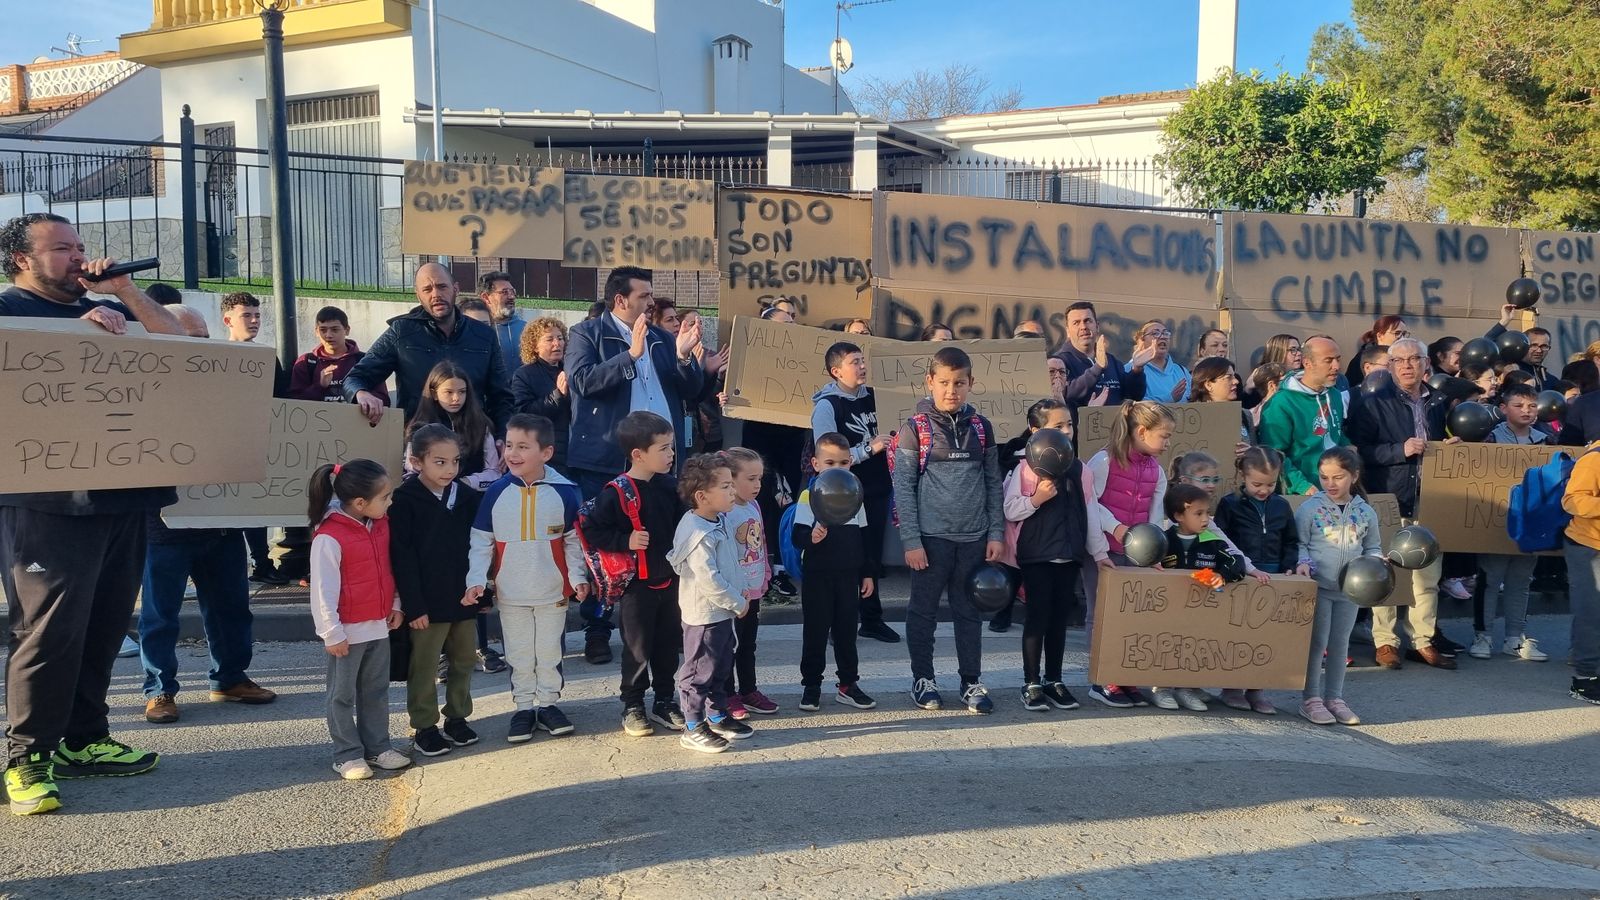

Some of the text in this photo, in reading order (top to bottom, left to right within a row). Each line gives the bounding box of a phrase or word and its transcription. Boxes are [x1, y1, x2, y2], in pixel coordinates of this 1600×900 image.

[404, 160, 459, 187] QUE
[565, 175, 598, 203] EL
[467, 184, 564, 217] PASAR
[727, 193, 834, 227] TODO
[579, 202, 688, 231] SE NOS
[458, 215, 487, 256] ?
[565, 234, 714, 266] CAE ENCIMA
[728, 228, 793, 256] SON
[1232, 220, 1489, 265] LA JUNTA NO
[1536, 236, 1594, 263] CON
[728, 256, 872, 293] PREGUNTAS
[1541, 271, 1600, 304] SEG
[1270, 269, 1445, 328] CUMPLE
[744, 326, 794, 350] VALLA
[2, 340, 266, 378] LOS PLAZOS SON LOS
[776, 356, 809, 373] NOS
[881, 358, 907, 382] LA
[999, 353, 1027, 374] EL
[22, 382, 76, 407] QUE
[1001, 379, 1028, 397] NO
[268, 402, 332, 433] MOS
[14, 438, 196, 474] PELIGRO
[266, 439, 348, 469] UDIAR
[251, 476, 310, 499] SEG
[1120, 580, 1169, 613] MAS
[1184, 584, 1220, 608] DE
[1229, 584, 1277, 629] 10
[1121, 632, 1273, 672] ESPERANDO
